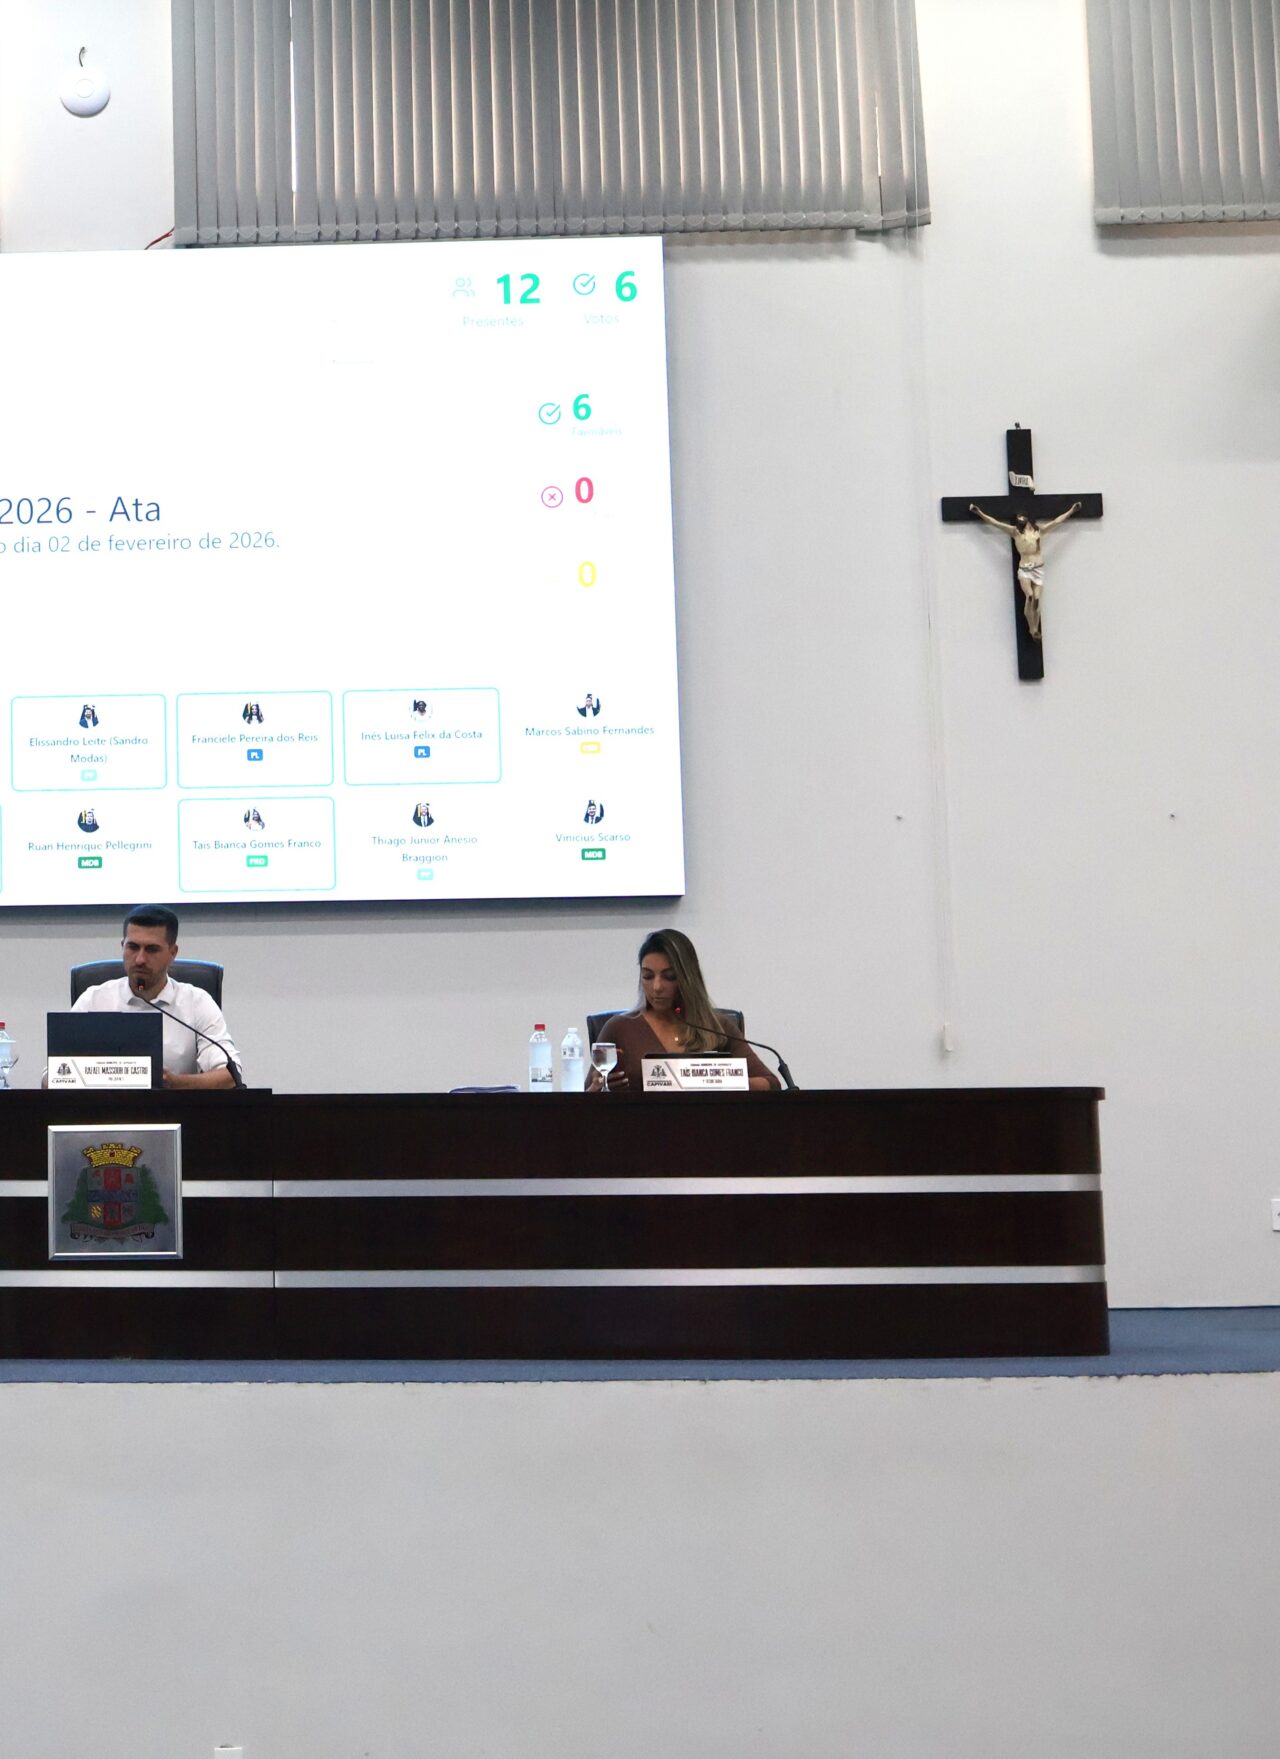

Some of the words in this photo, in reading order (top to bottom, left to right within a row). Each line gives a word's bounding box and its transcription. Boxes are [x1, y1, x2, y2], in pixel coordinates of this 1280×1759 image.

[497, 273, 541, 304] 12
[615, 271, 638, 302] 6
[462, 315, 524, 327] Presentes
[583, 312, 620, 325] Votos
[573, 394, 592, 421] 6
[575, 477, 593, 503] 0
[109, 496, 160, 522] Ata
[14, 537, 40, 552] dia
[49, 536, 69, 552] 02
[79, 536, 100, 551] de
[109, 535, 191, 550] fevereiro
[199, 534, 221, 548] de
[228, 531, 281, 550] 2026.
[579, 562, 596, 587] 0
[438, 730, 452, 739] da
[454, 730, 483, 738] Costa
[524, 728, 562, 736] Marcos
[564, 727, 600, 735] Sabino
[602, 726, 655, 734] Fernandes
[29, 737, 80, 747] Elissandro
[109, 736, 149, 745] (Sandro
[191, 735, 237, 743] Franciele
[239, 734, 274, 742] Pereira
[276, 734, 295, 742] dos
[297, 733, 319, 741] Reis
[70, 754, 108, 764] Modas)
[372, 836, 406, 847] Thiago
[598, 833, 631, 841] Scarso
[27, 842, 54, 851] Ruan
[56, 842, 103, 852] Henrique
[105, 841, 152, 851] Pellegrini
[214, 841, 247, 849] Bianca
[249, 840, 285, 848] Gomes
[287, 839, 322, 848] Franco
[401, 854, 448, 864] Braggion
